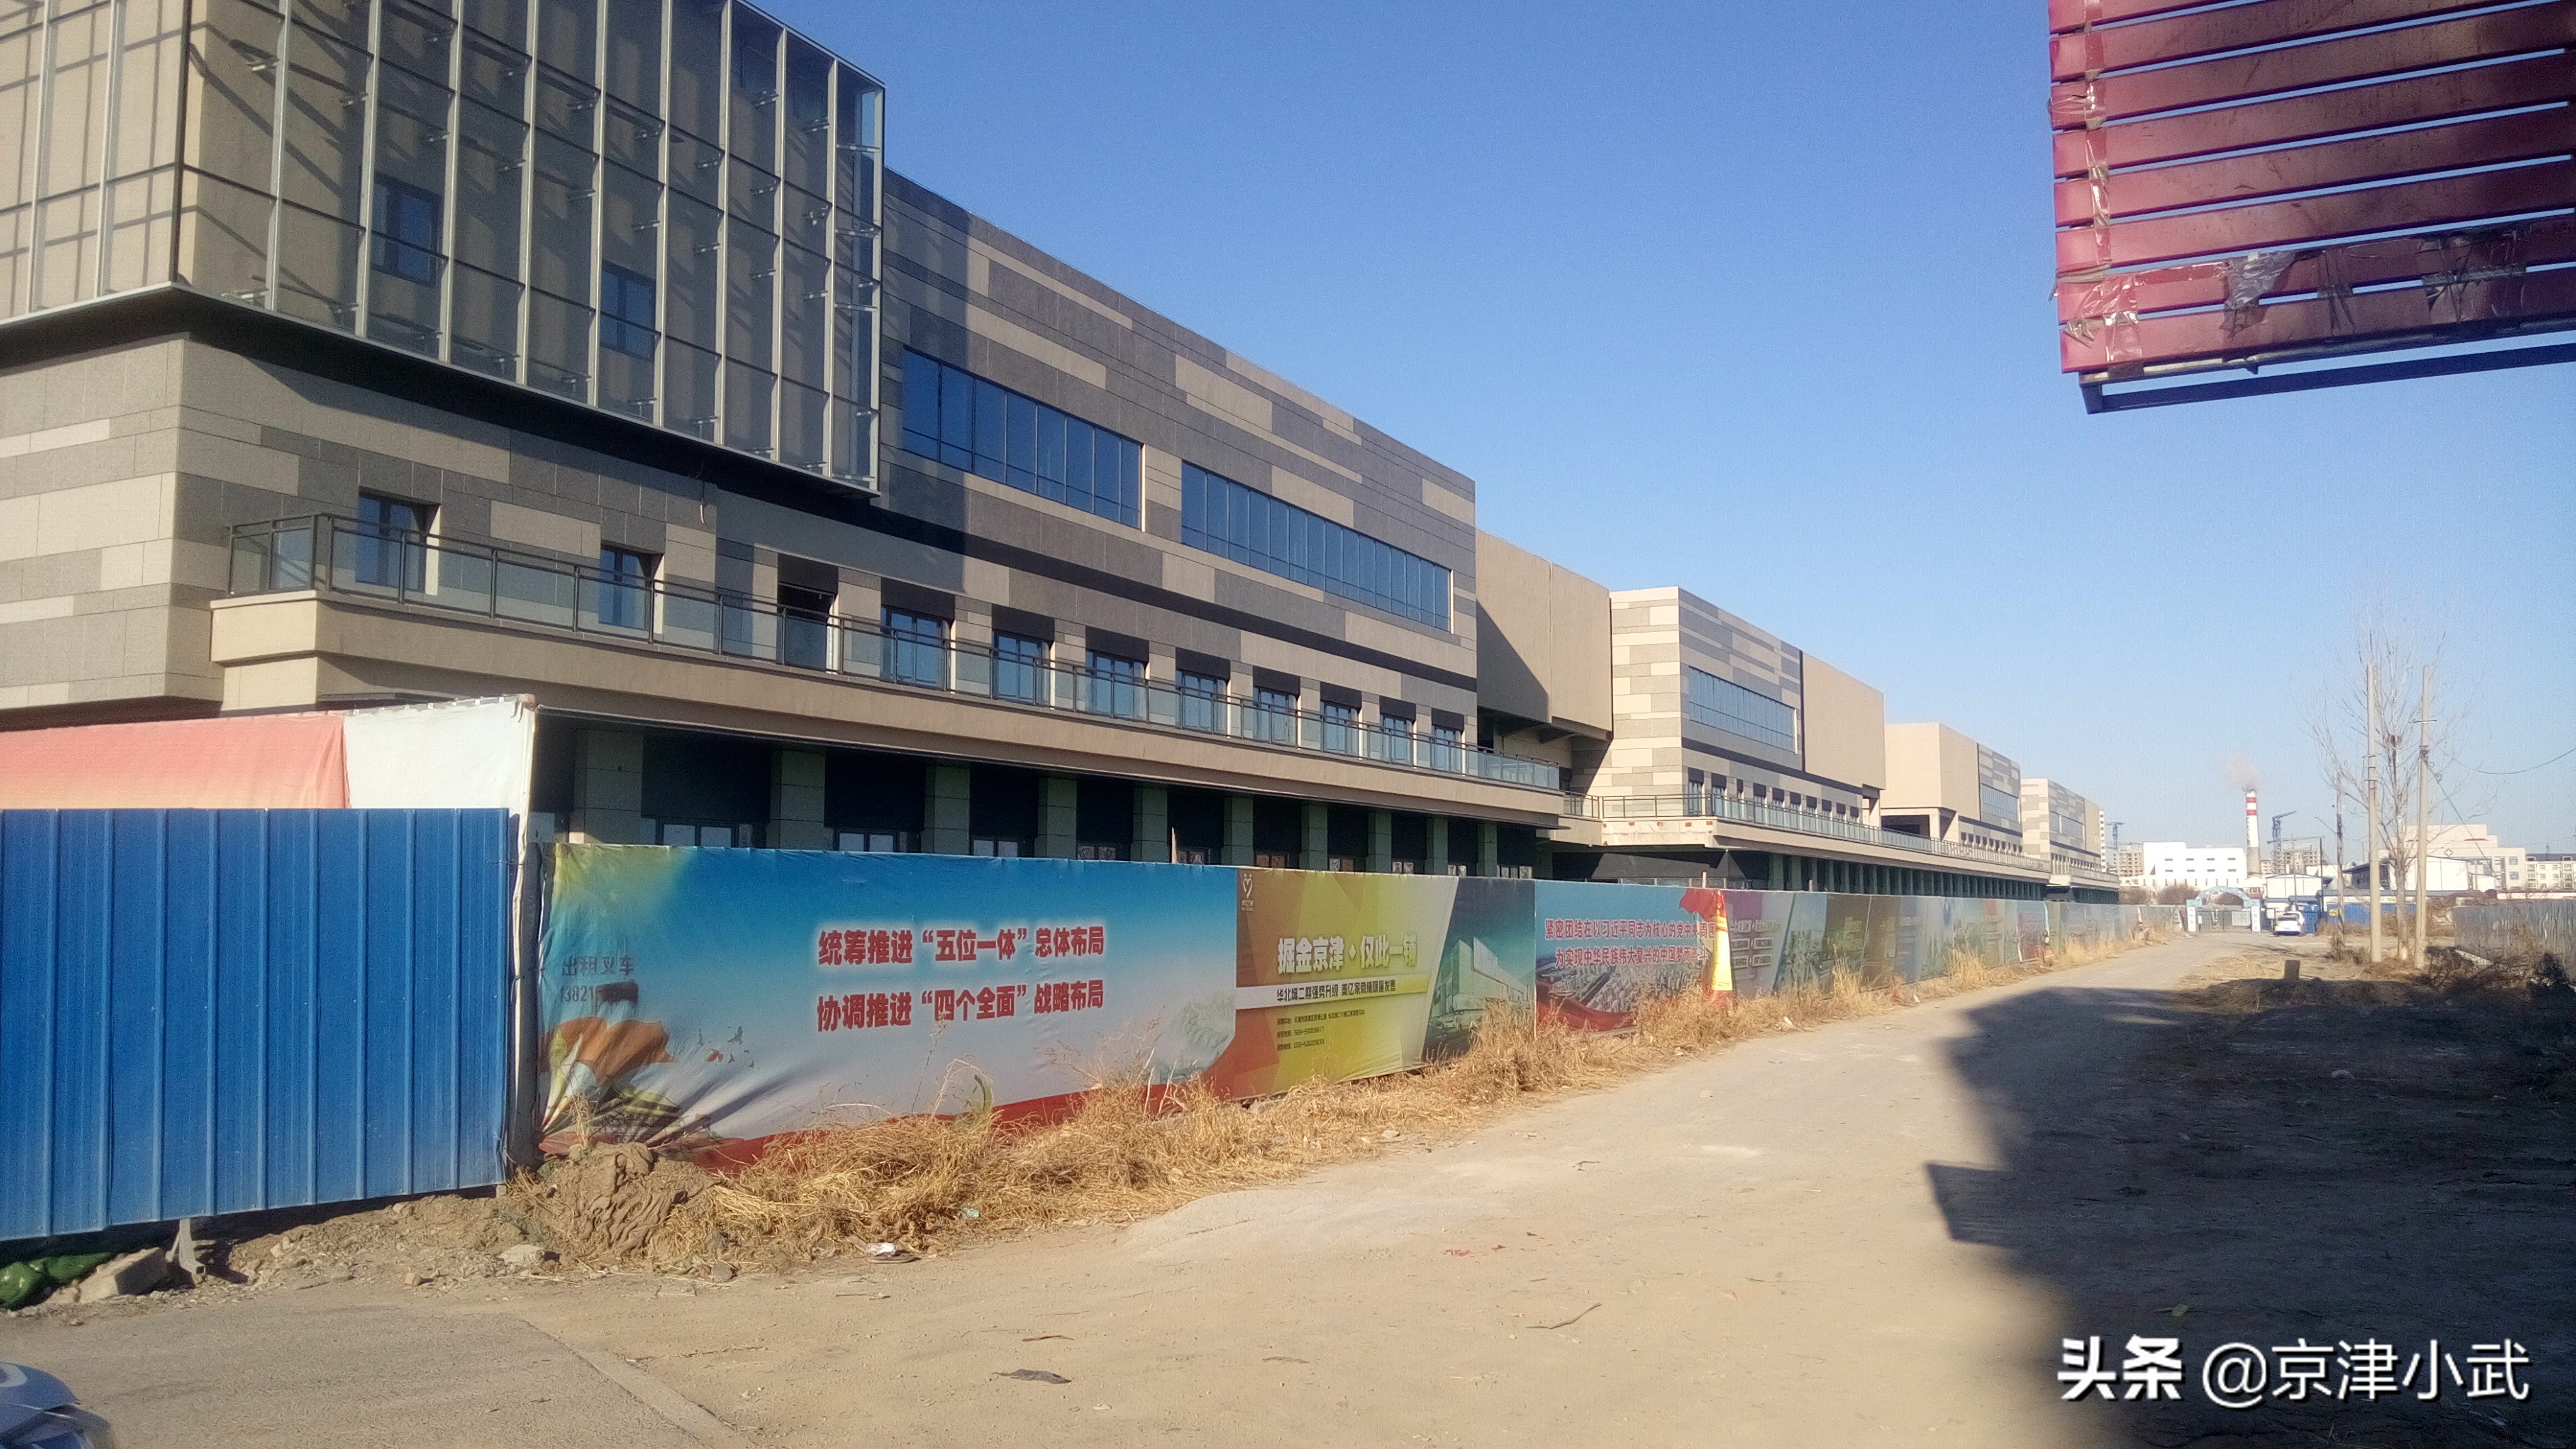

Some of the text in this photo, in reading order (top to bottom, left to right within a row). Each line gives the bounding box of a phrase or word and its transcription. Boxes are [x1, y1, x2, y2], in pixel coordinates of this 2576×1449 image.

[562, 955, 634, 977] 出租叉车
[818, 926, 1104, 966] 统筹推进“五位一体”总体布局
[818, 980, 1104, 1032] 协调推进“四个全面”战略布局
